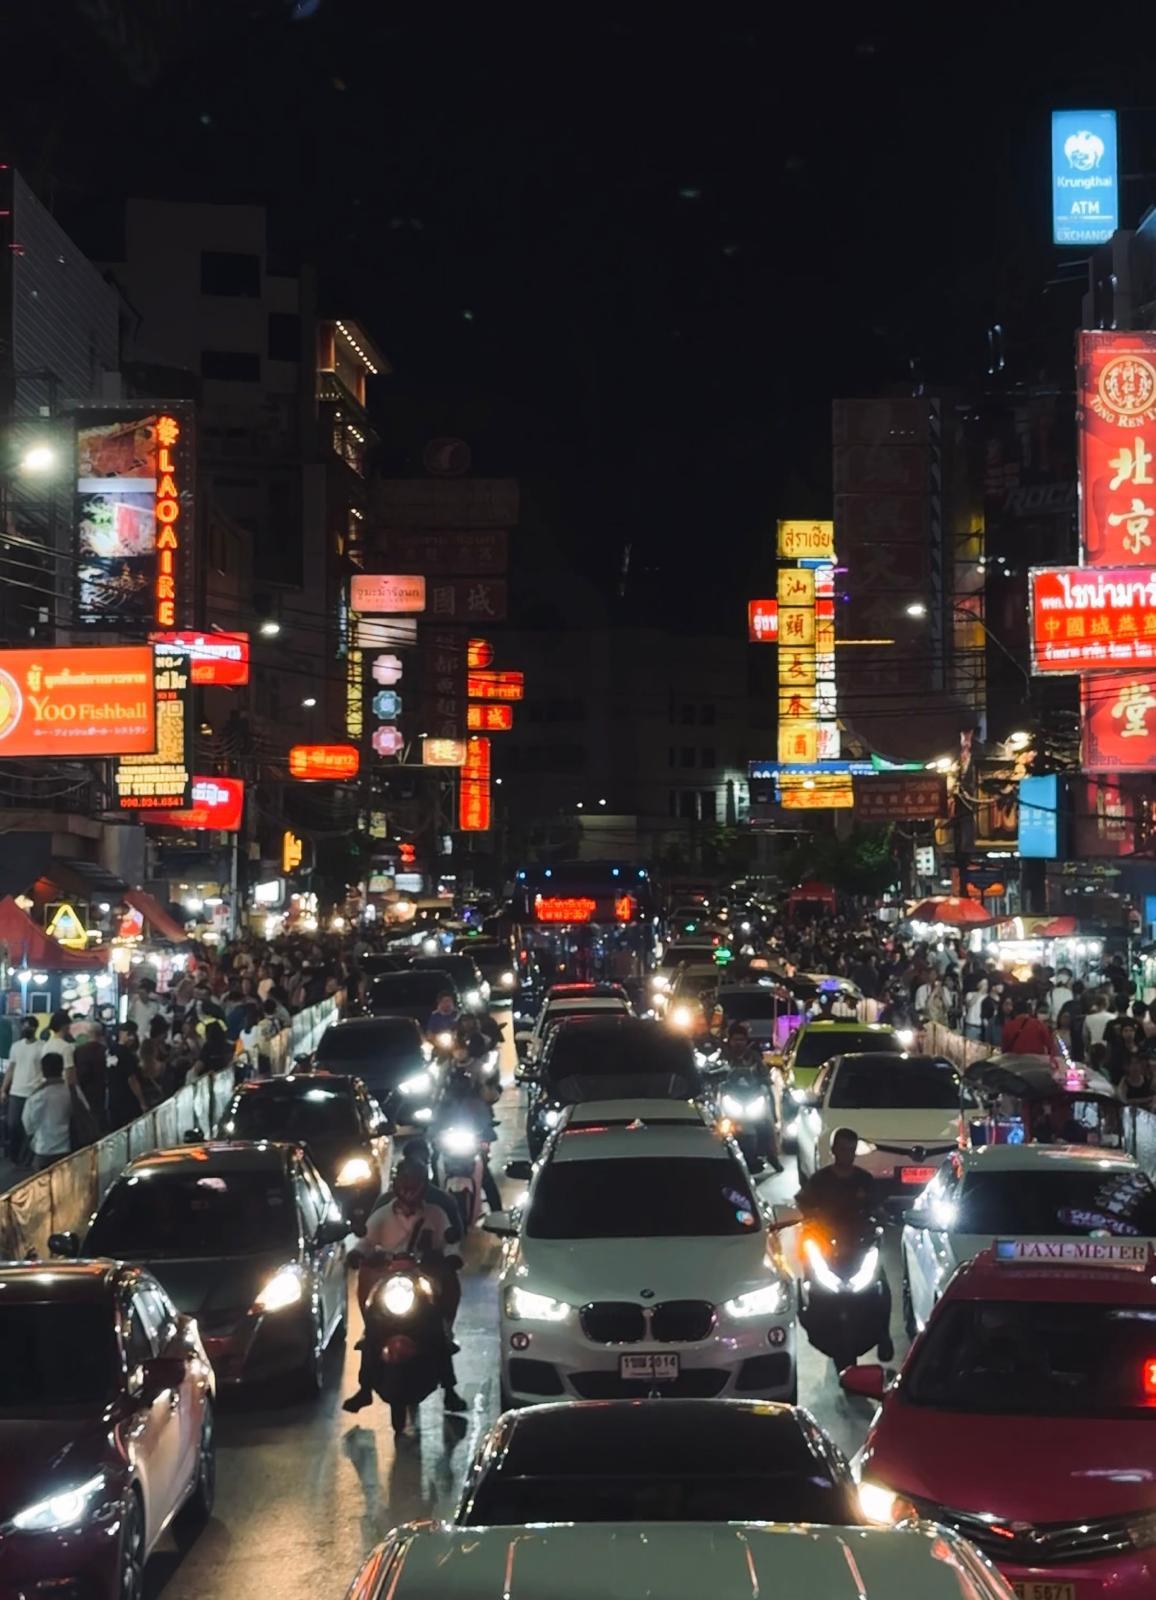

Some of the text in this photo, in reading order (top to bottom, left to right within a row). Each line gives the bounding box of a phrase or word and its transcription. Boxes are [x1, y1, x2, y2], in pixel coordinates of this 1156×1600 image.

[1057, 176, 1112, 190] Krungthai
[1071, 201, 1100, 215] ATM
[1117, 415, 1145, 428] REN
[79, 702, 147, 720] Fishball
[1015, 1243, 1146, 1261] TAXI-METER
